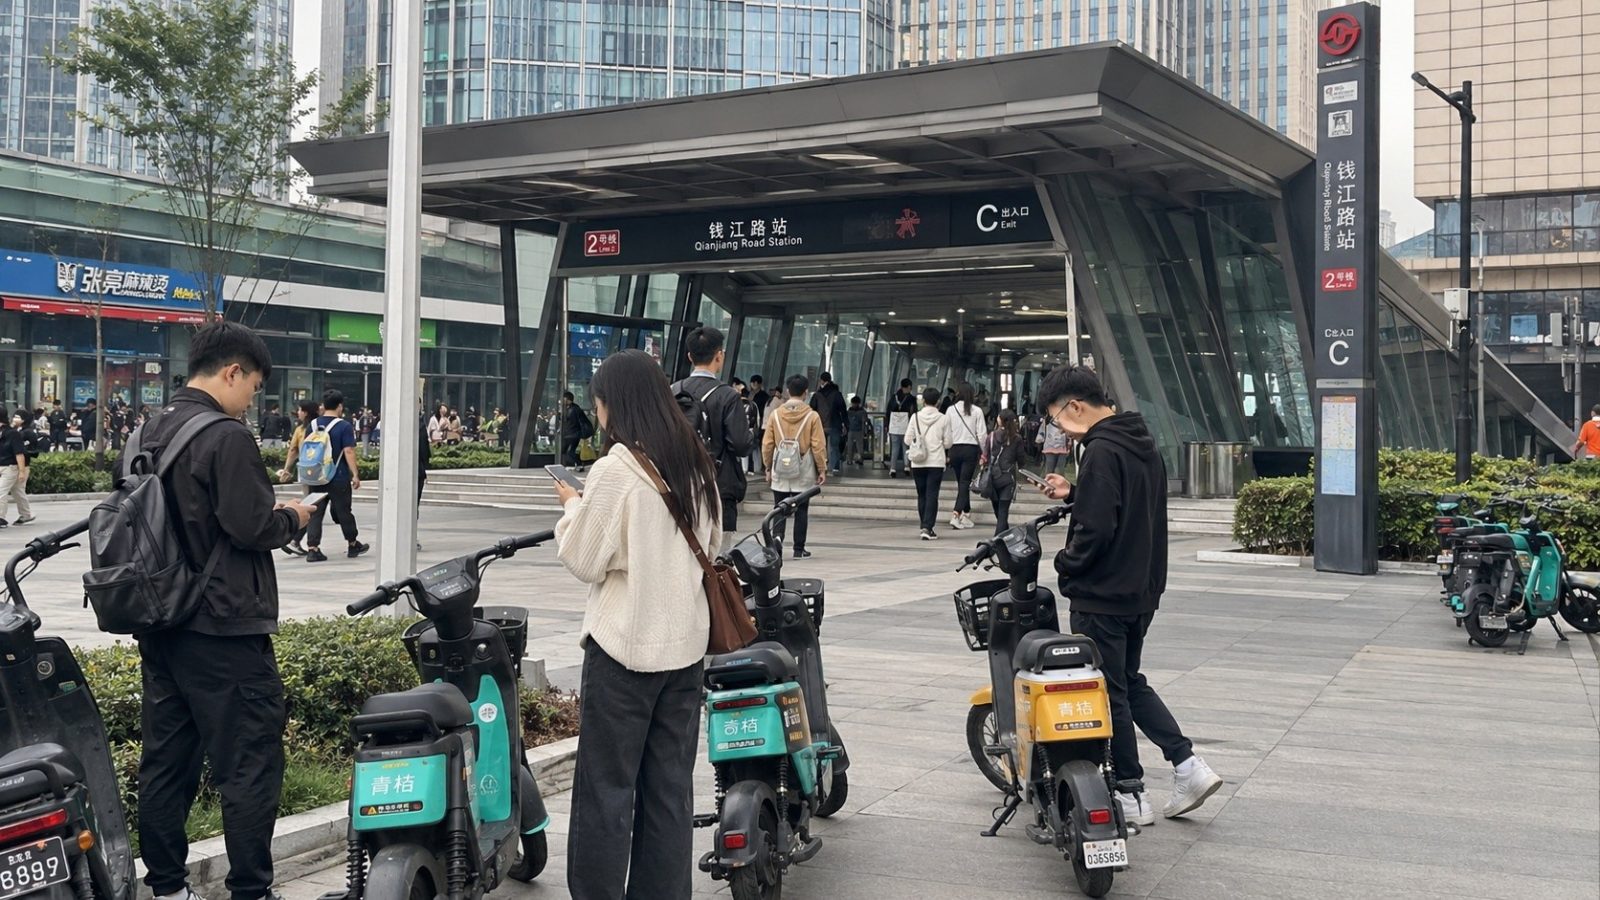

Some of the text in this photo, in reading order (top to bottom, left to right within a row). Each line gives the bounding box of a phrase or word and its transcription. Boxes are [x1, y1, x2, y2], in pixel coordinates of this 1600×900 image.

[1001, 206, 1029, 217] 出入口
[1336, 159, 1356, 250] 钱江路站
[708, 217, 788, 240] 钱江路站
[976, 203, 999, 232] C
[694, 235, 803, 252] Qianjiang Road Station
[80, 265, 170, 297] 张亮麻辣烫
[1325, 272, 1335, 289] 2
[1328, 340, 1350, 366] C
[371, 773, 415, 796] 青桔
